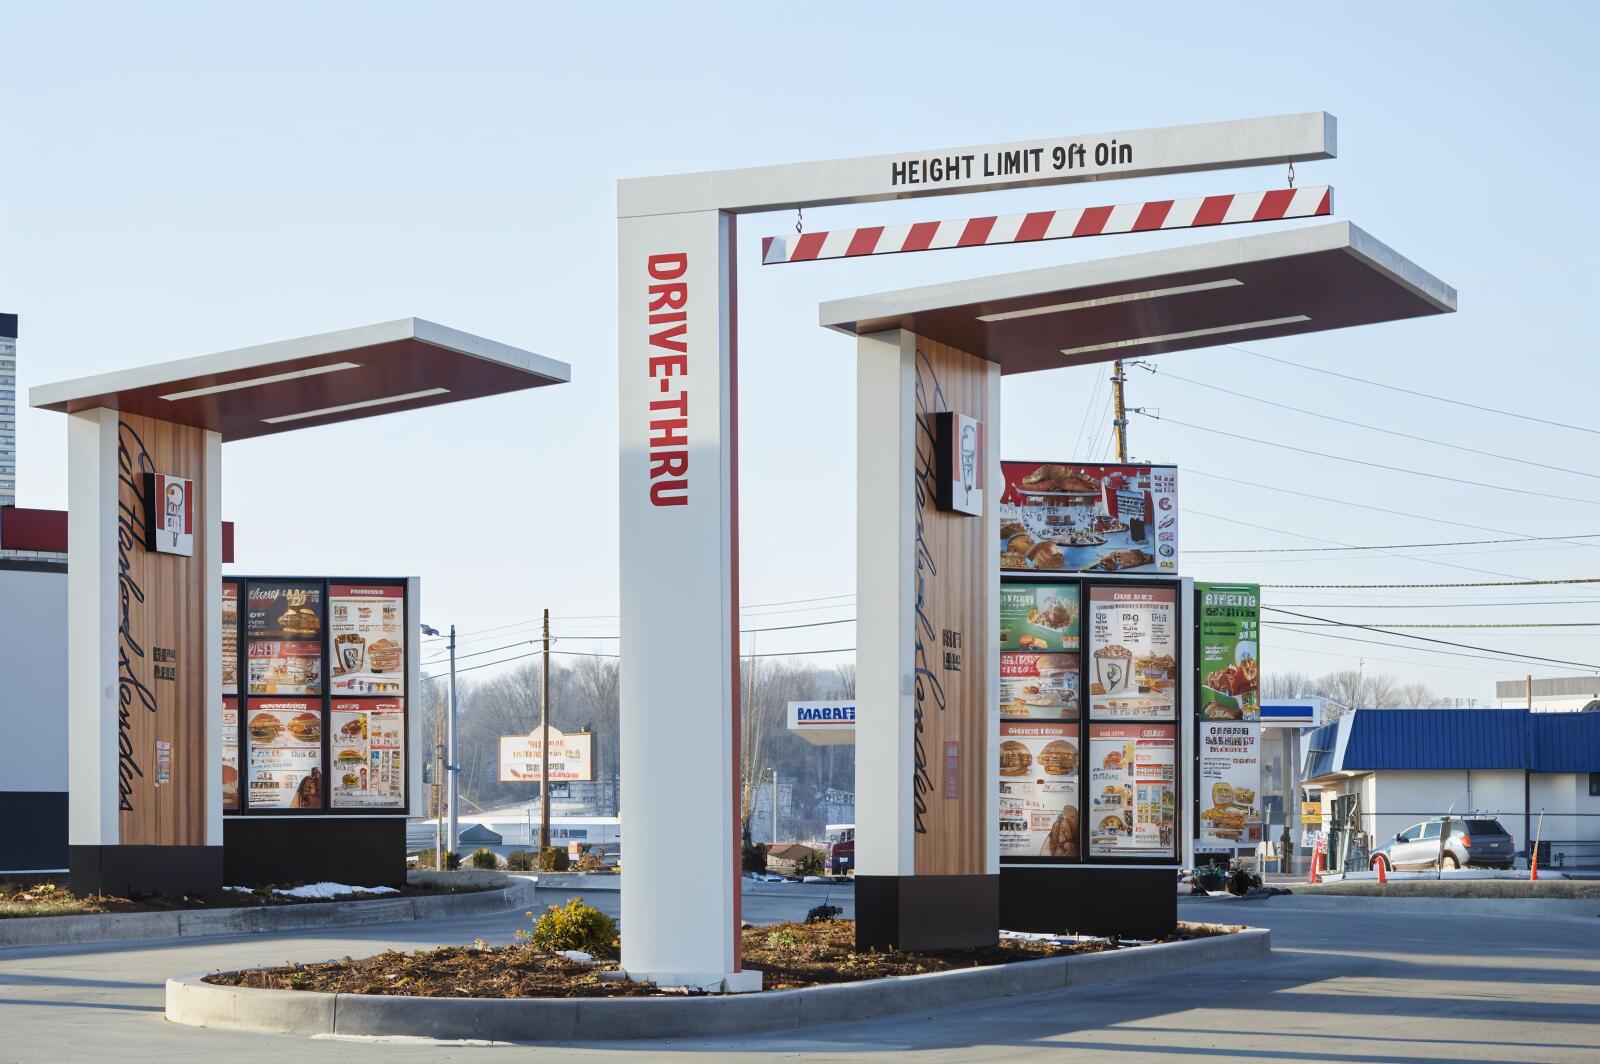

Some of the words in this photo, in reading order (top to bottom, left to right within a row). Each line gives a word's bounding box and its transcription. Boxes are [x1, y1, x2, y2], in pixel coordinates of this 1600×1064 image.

[892, 155, 974, 185] HEIGHT
[983, 148, 1044, 177] LIMIT
[1052, 143, 1087, 170] 9ft
[1094, 139, 1133, 166] 0in
[648, 252, 688, 507] DRIVE-THRU
